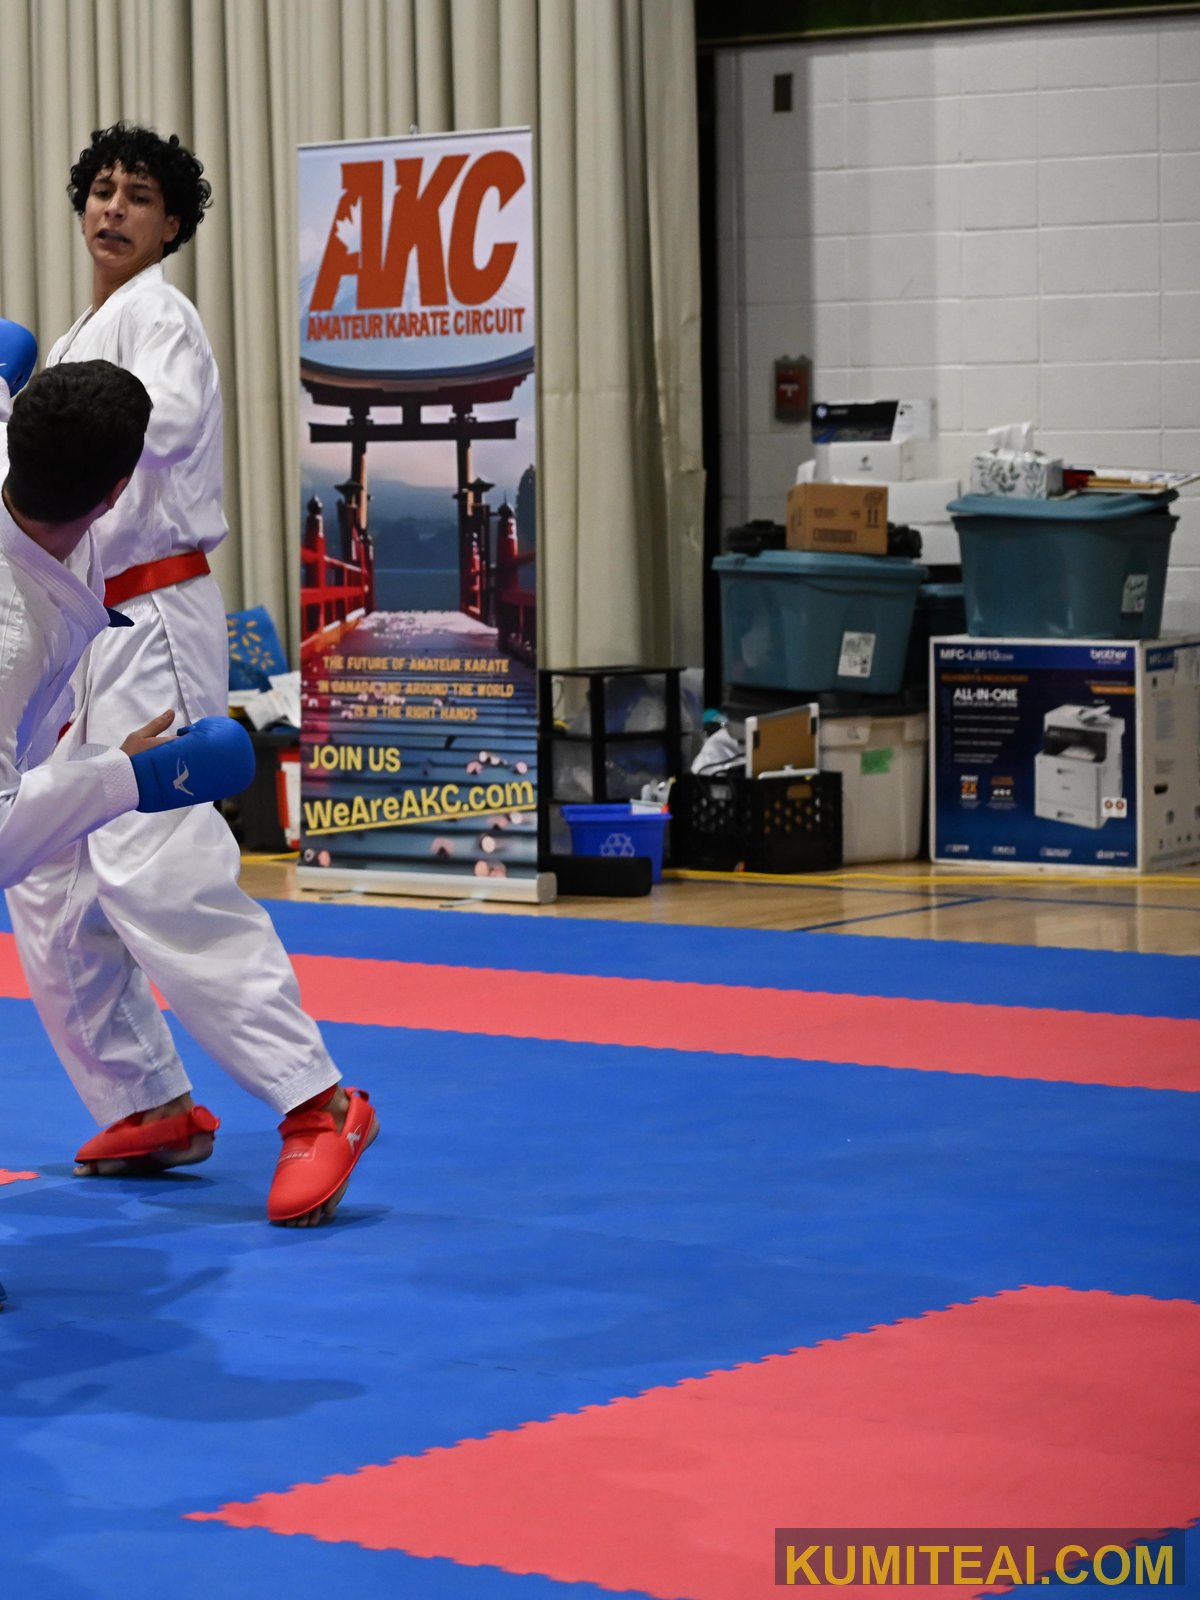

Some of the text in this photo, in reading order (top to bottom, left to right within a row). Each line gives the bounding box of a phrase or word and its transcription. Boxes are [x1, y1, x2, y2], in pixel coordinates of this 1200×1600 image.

[308, 150, 526, 312] AKC
[307, 308, 525, 341] AMATEUR KARATE CIRCUIT
[323, 656, 509, 673] THE FUTURE OF AMATEUR KARATE
[317, 680, 329, 693] IN
[381, 682, 401, 695] AND
[406, 682, 449, 696] AROUND
[453, 683, 474, 697] THE
[477, 683, 514, 698] WORLD
[953, 688, 1018, 701] ALL-IN-ONE
[353, 705, 478, 720] IS IN THE RIGHT HANDS
[308, 746, 401, 772] JOIN US
[304, 780, 535, 830] WeAreAKC.com
